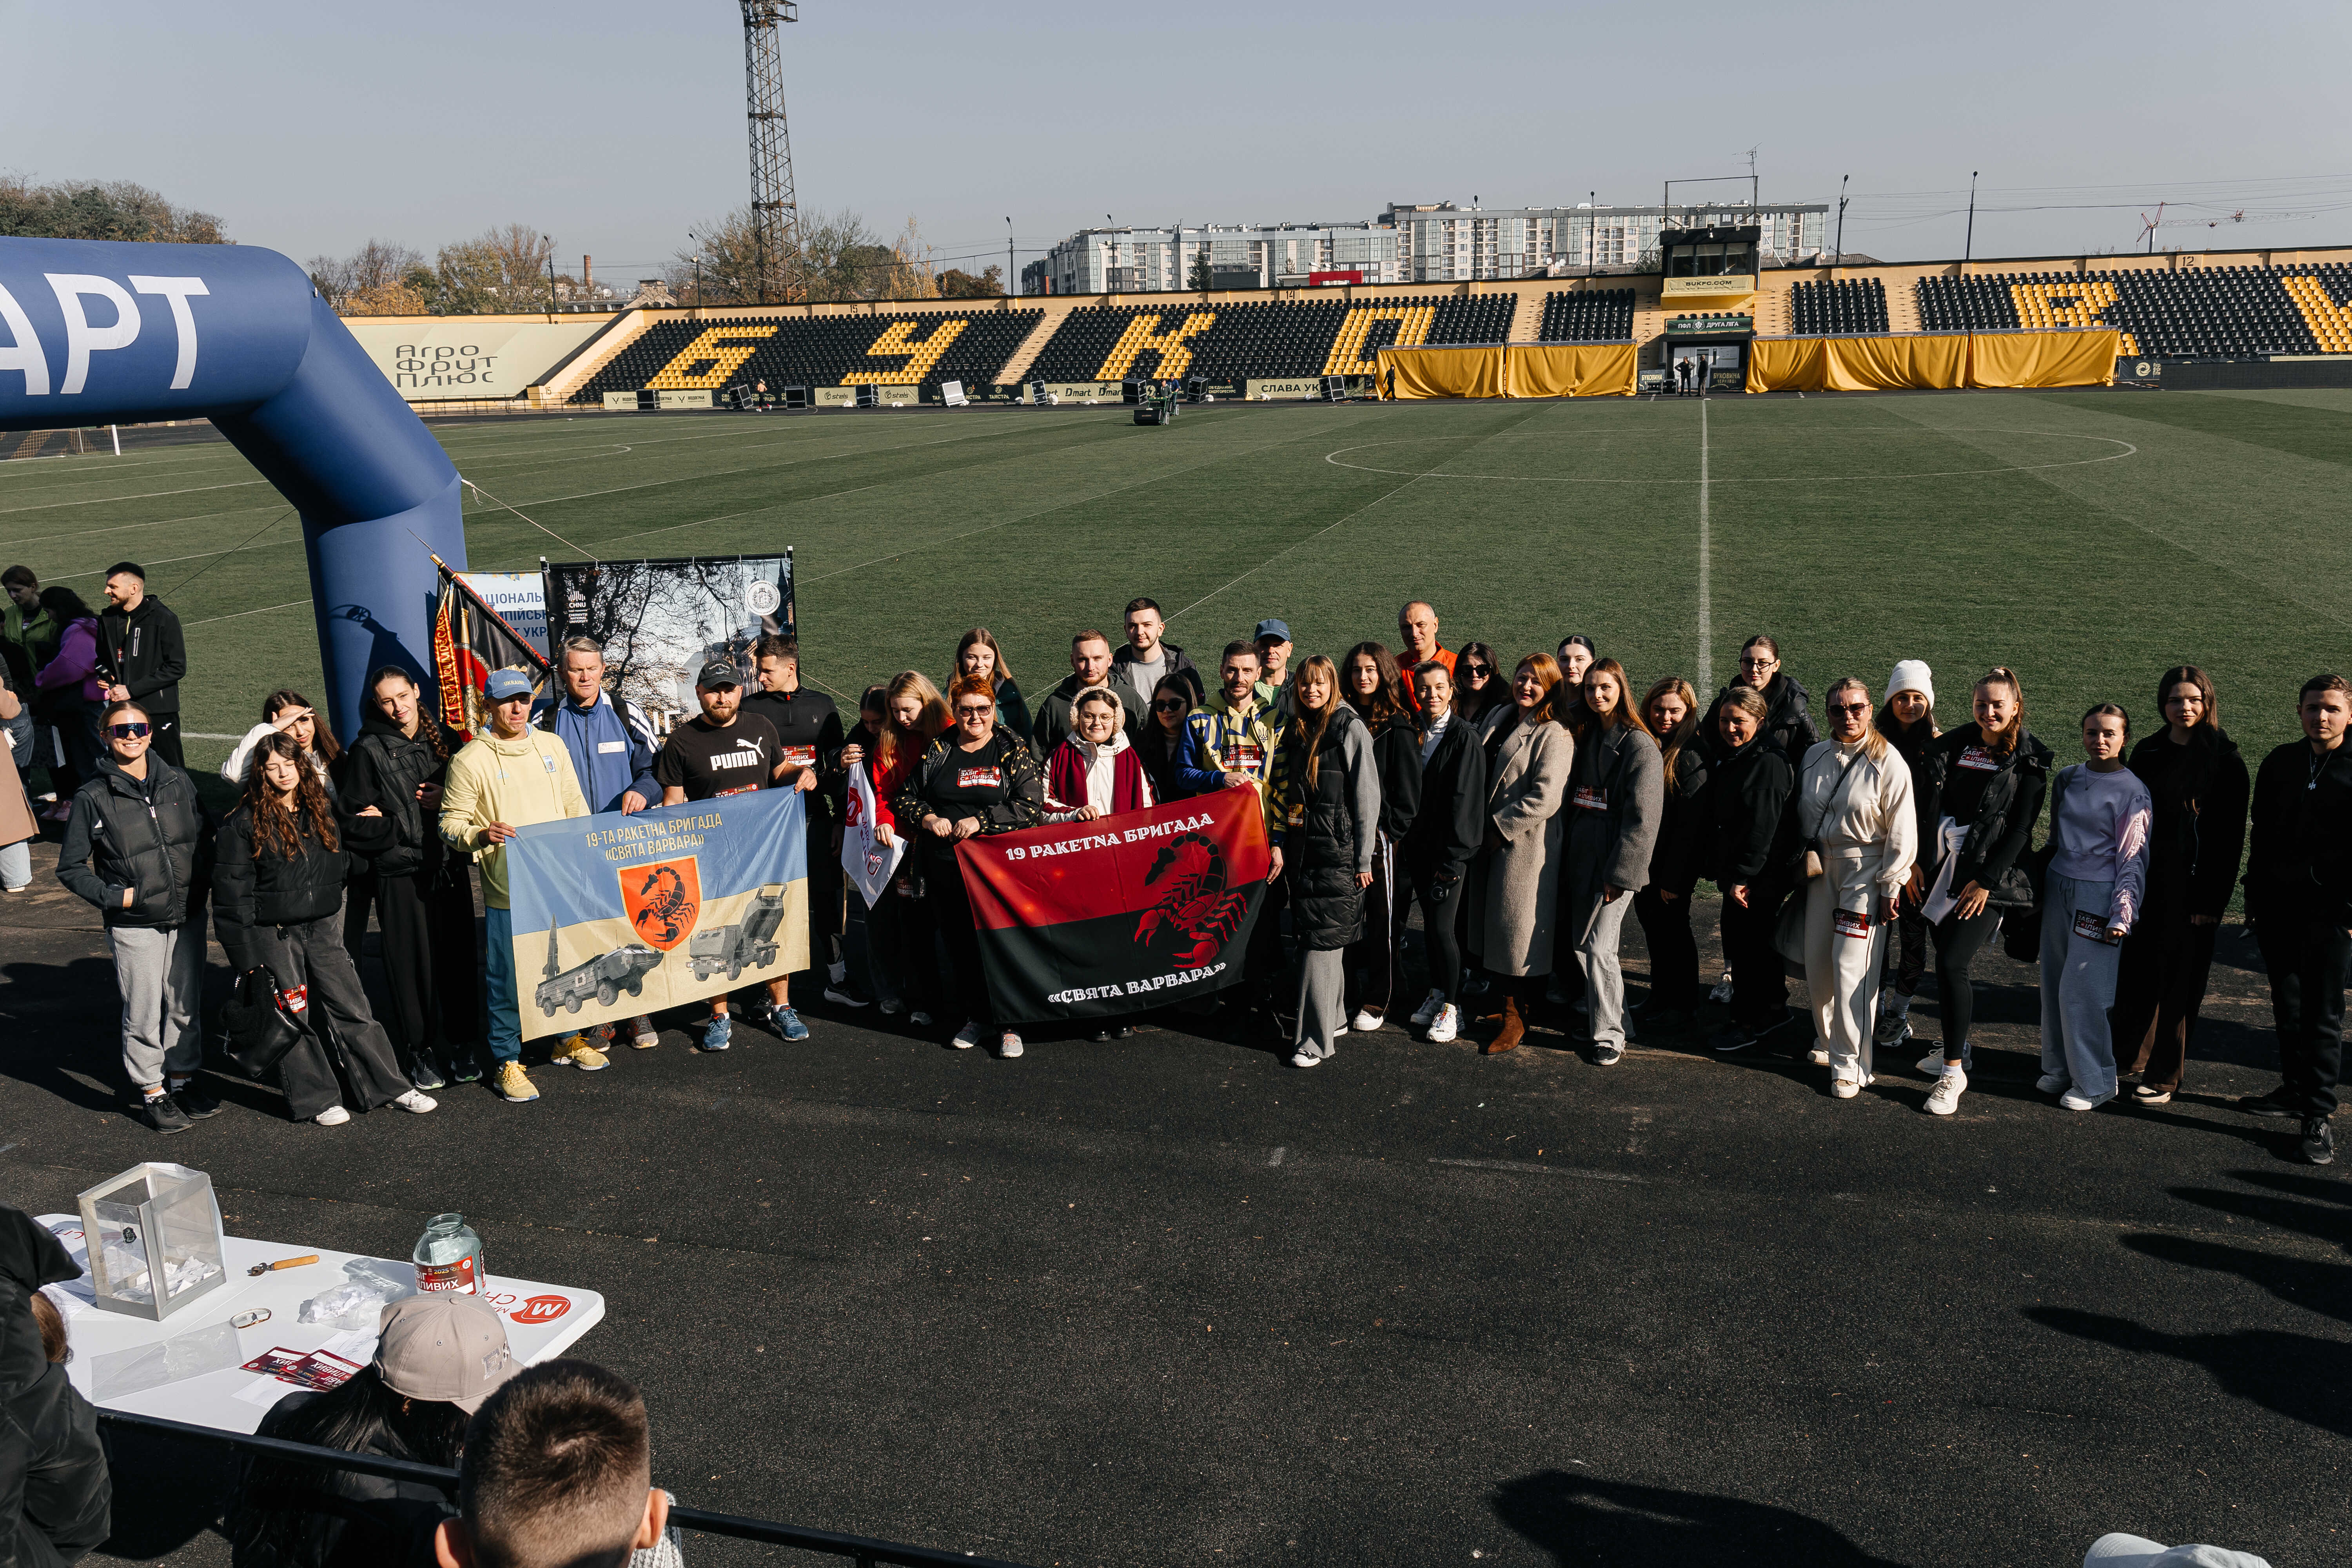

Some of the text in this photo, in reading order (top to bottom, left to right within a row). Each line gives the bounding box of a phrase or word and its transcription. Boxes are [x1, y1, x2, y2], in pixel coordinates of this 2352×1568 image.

[2183, 256, 2194, 267] 12
[1286, 290, 1295, 300] 14
[850, 304, 858, 313] 15
[396, 345, 479, 360] Агро
[396, 356, 498, 375] Фрут
[396, 372, 494, 388] Плюс
[1261, 383, 1301, 392] СЛАВА
[710, 750, 758, 771] PUMA
[585, 813, 723, 848] 19-ТА РАКЕТНА БРИГАДА
[1005, 847, 1026, 861] 19
[1123, 813, 1215, 843] БРИГАДА
[605, 833, 705, 861] «СВЯТА ВАРВАРА»
[2077, 915, 2097, 924] ЗАБІГ
[1047, 962, 1227, 1004] «СВЯТА ВАРВАРА»
